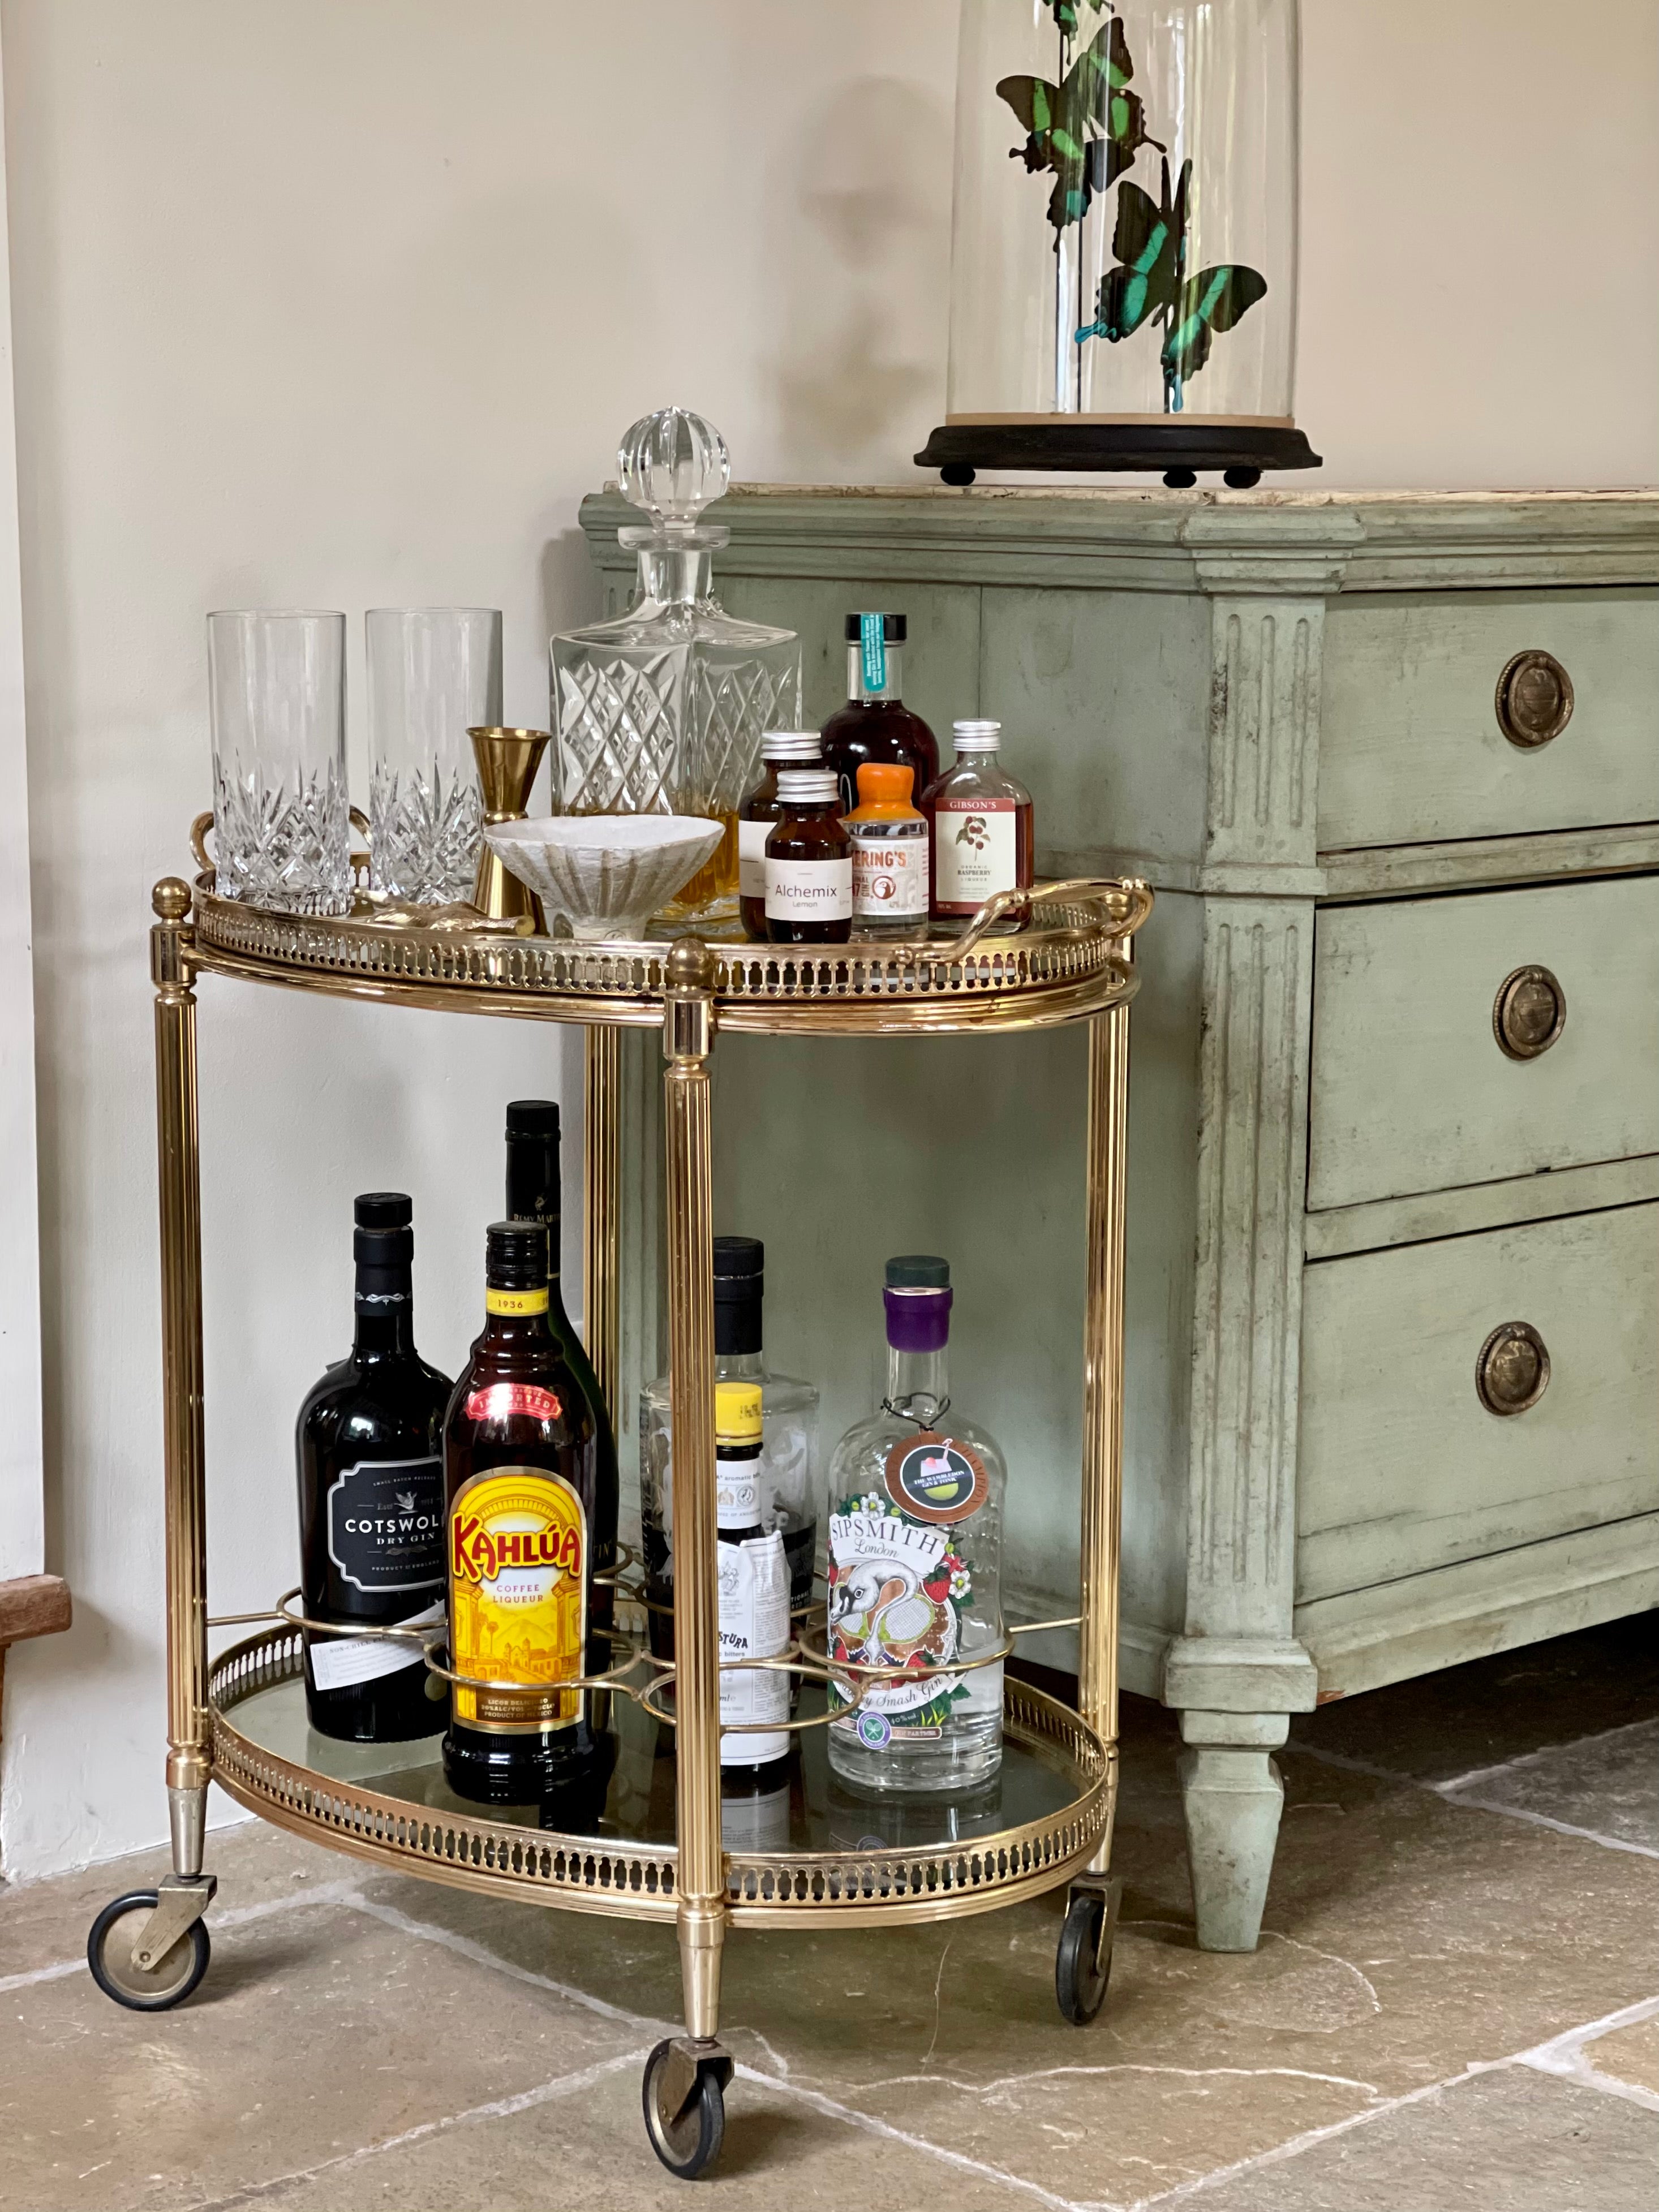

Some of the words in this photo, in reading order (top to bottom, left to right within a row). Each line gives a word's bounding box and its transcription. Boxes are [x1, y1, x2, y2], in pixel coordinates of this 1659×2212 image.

[949, 801, 997, 809] GIBSON'S
[775, 884, 837, 897] Alchemix
[498, 1299, 523, 1309] 1936
[479, 1393, 551, 1409] IORTED
[345, 1514, 439, 1534] COTSWOL
[377, 1537, 405, 1545] DRY
[410, 1532, 435, 1542] GIN
[831, 1518, 940, 1555] SIPSMITH
[454, 1515, 581, 1580] KAHLÚA
[854, 1538, 899, 1557] London
[493, 1595, 544, 1603] LIQUEUR
[719, 1632, 748, 1649] STURA
[876, 1689, 916, 1707] Smash
[916, 1676, 943, 1697] Gin
